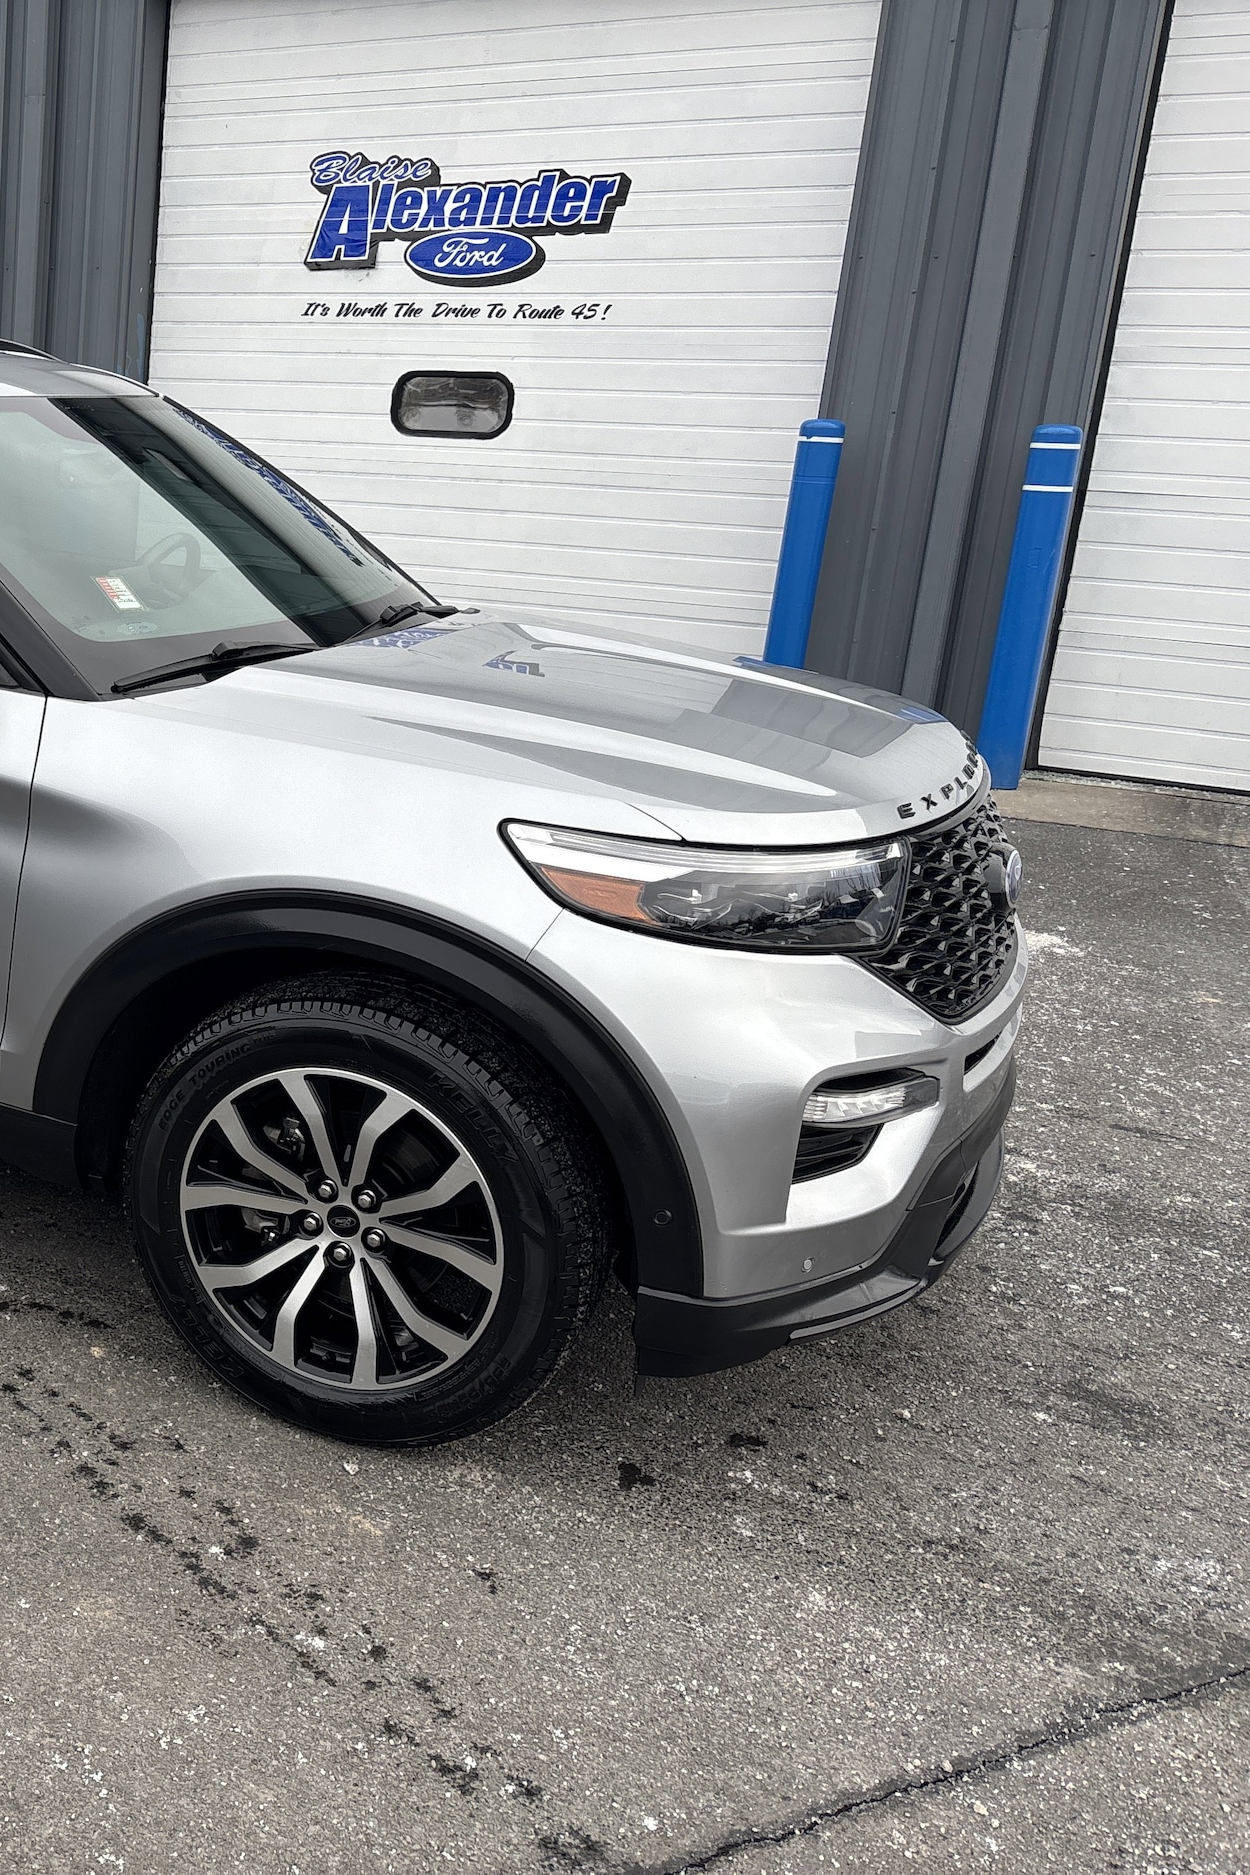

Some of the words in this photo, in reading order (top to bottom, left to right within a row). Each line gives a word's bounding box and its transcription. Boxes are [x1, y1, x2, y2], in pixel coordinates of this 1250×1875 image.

[312, 153, 433, 186] Blaise
[307, 172, 619, 263] Alexander
[434, 237, 505, 268] Ford
[301, 302, 330, 317] It's
[335, 302, 388, 318] Worth
[394, 302, 423, 318] The
[431, 302, 481, 318] Drive
[487, 303, 507, 319] To
[513, 303, 565, 320] Route
[158, 1089, 186, 1131] EDGE
[188, 1043, 252, 1086] TOURING
[424, 1072, 519, 1164] KELLY
